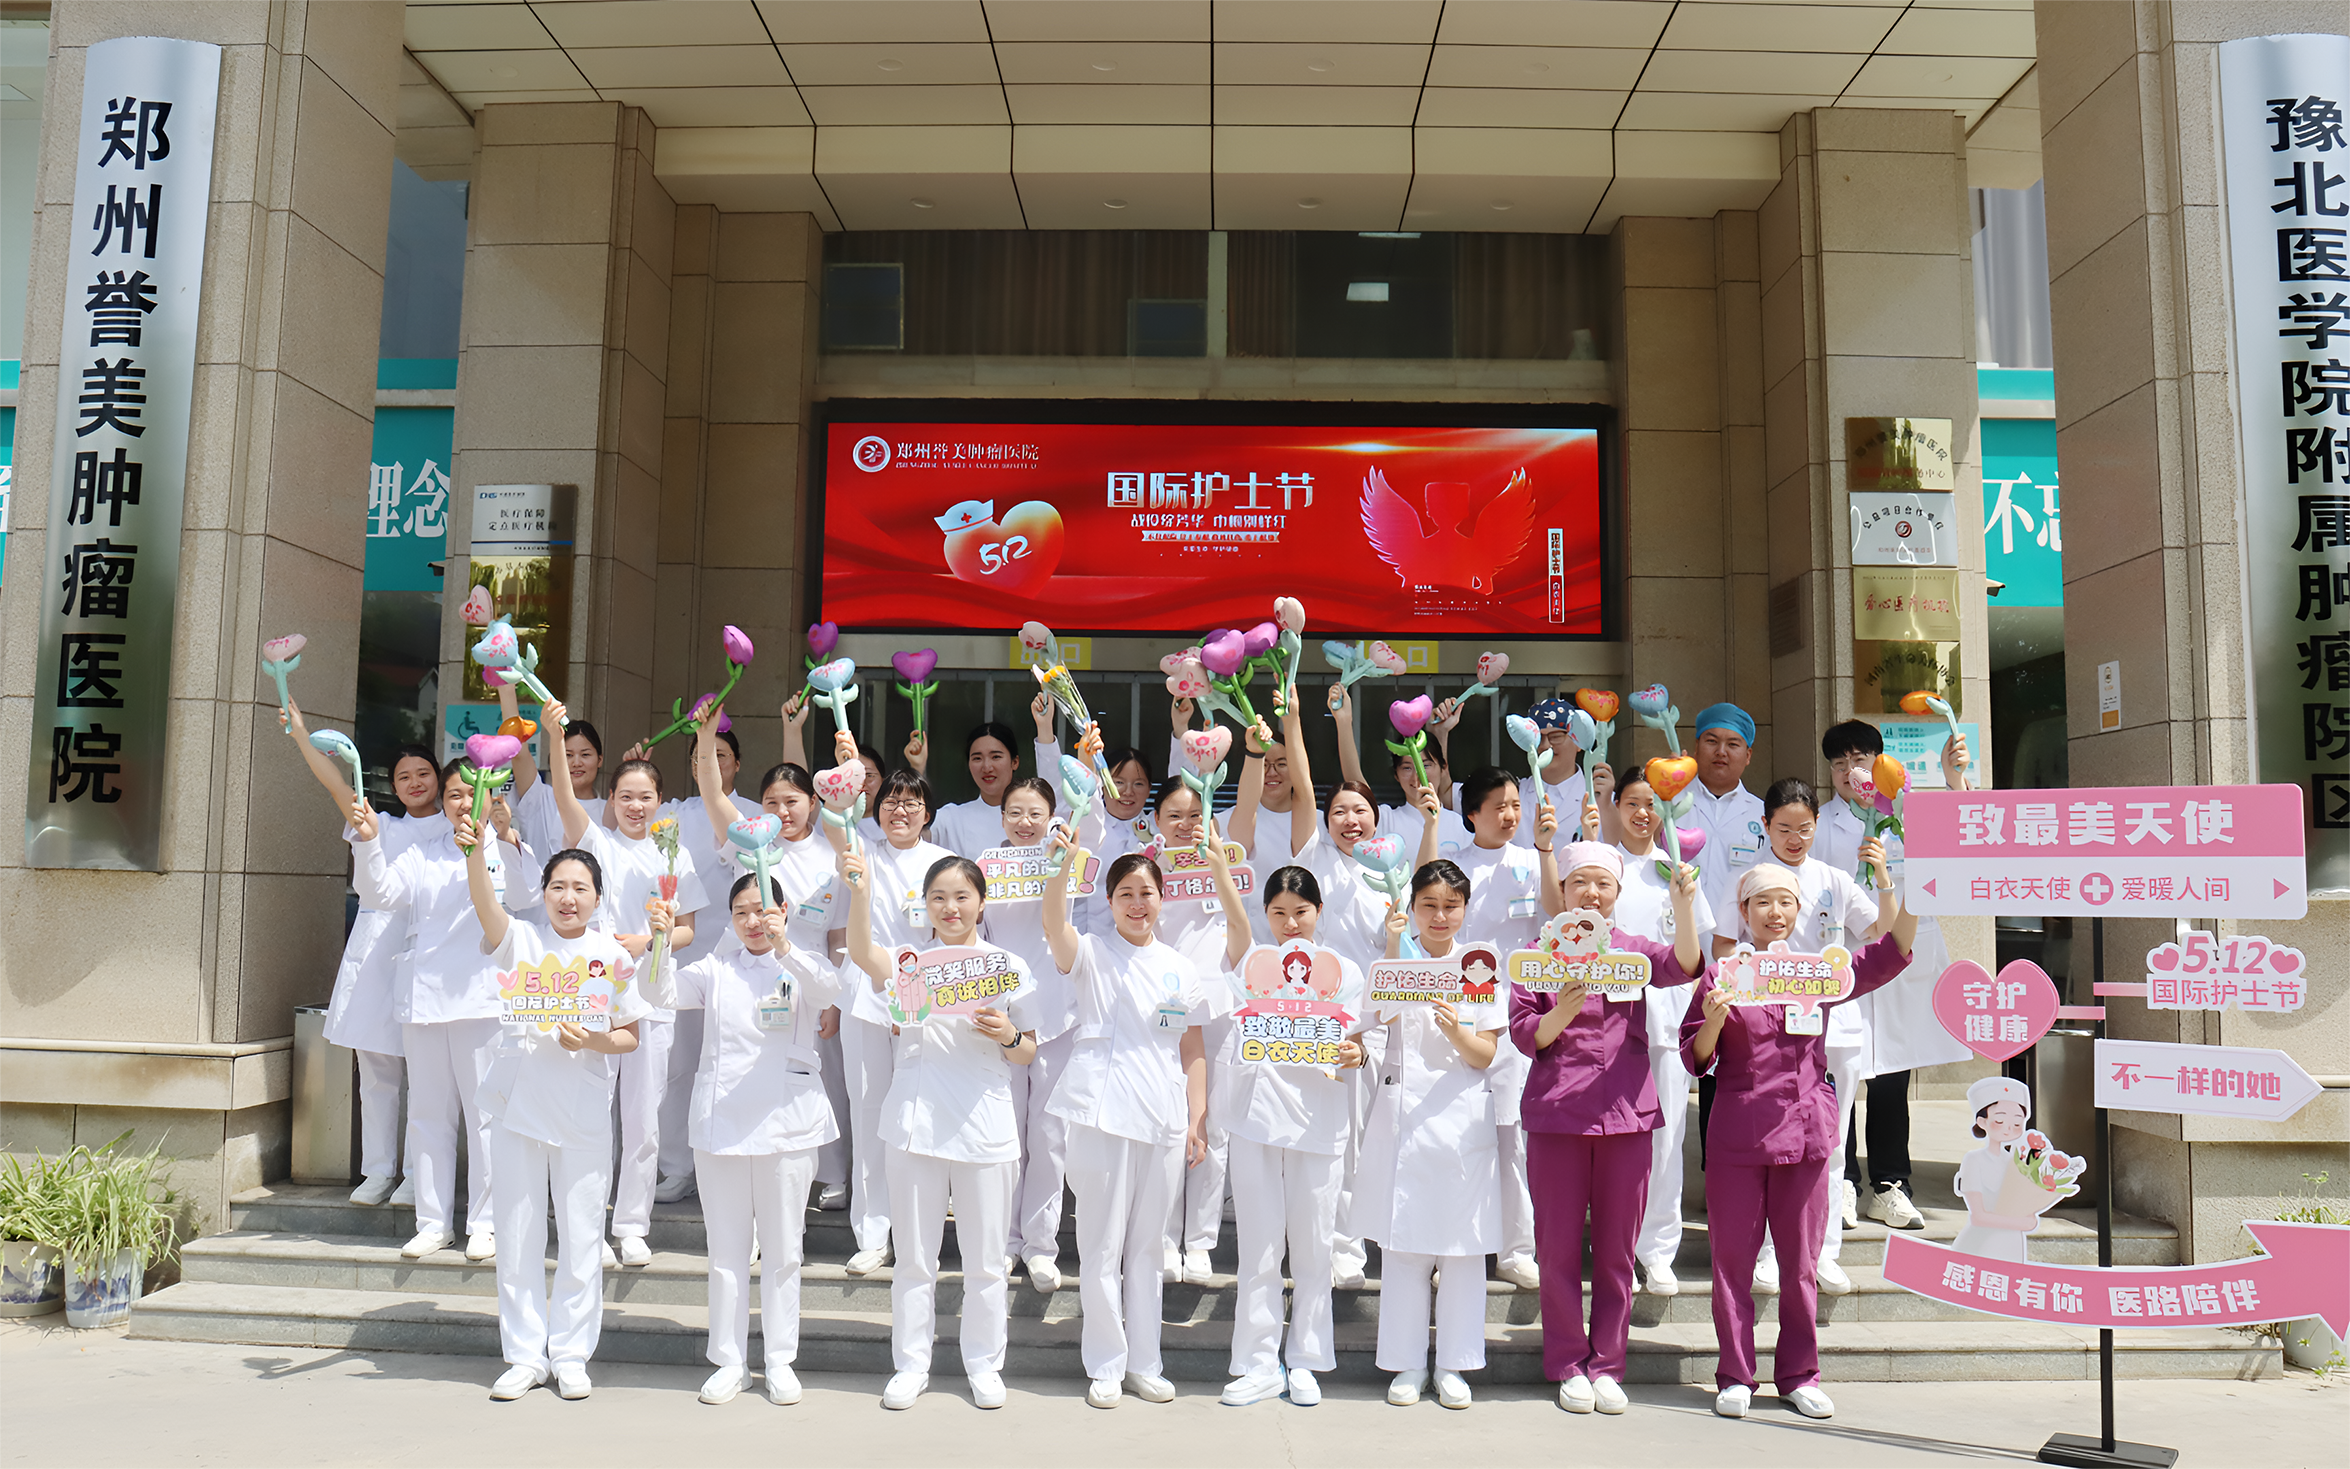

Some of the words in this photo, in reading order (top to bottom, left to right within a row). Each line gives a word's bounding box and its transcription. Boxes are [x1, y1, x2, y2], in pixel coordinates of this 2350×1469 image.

[49, 96, 172, 804] 郑州誉美肿瘤医院
[896, 443, 1039, 460] 郑州誉美肿瘤医院
[1107, 471, 1315, 510] 国际护士节
[1959, 800, 2235, 845] 致最美天使
[987, 858, 1076, 879] 平凡的
[987, 877, 1077, 899] 非凡的
[1161, 874, 1250, 898] 丁格尔!
[1970, 876, 2071, 901] 白衣天使
[2122, 876, 2230, 902] 爱暖人间
[2182, 936, 2267, 974] 5.12
[924, 952, 1008, 986] 微笑服务
[1375, 970, 1458, 989] 护佑生命
[1520, 959, 1645, 981] 用心守护你!
[1759, 959, 1833, 978] 护佑生命
[525, 971, 579, 995] 5.12
[936, 972, 1020, 1007] 真诚相伴
[1962, 981, 2027, 1010] 守护
[2152, 979, 2300, 1008] 国际护士节
[511, 995, 590, 1011] 国际护士节
[1466, 993, 1495, 1003] LIFE
[1243, 1015, 1342, 1041] 致敬最美
[1963, 1014, 2028, 1043] 健康
[1242, 1039, 1340, 1064] 白衣天使
[2111, 1062, 2281, 1101] 不一样的她
[1942, 1261, 2083, 1314] 感恩有你
[2108, 1279, 2260, 1317] 医路陪伴
